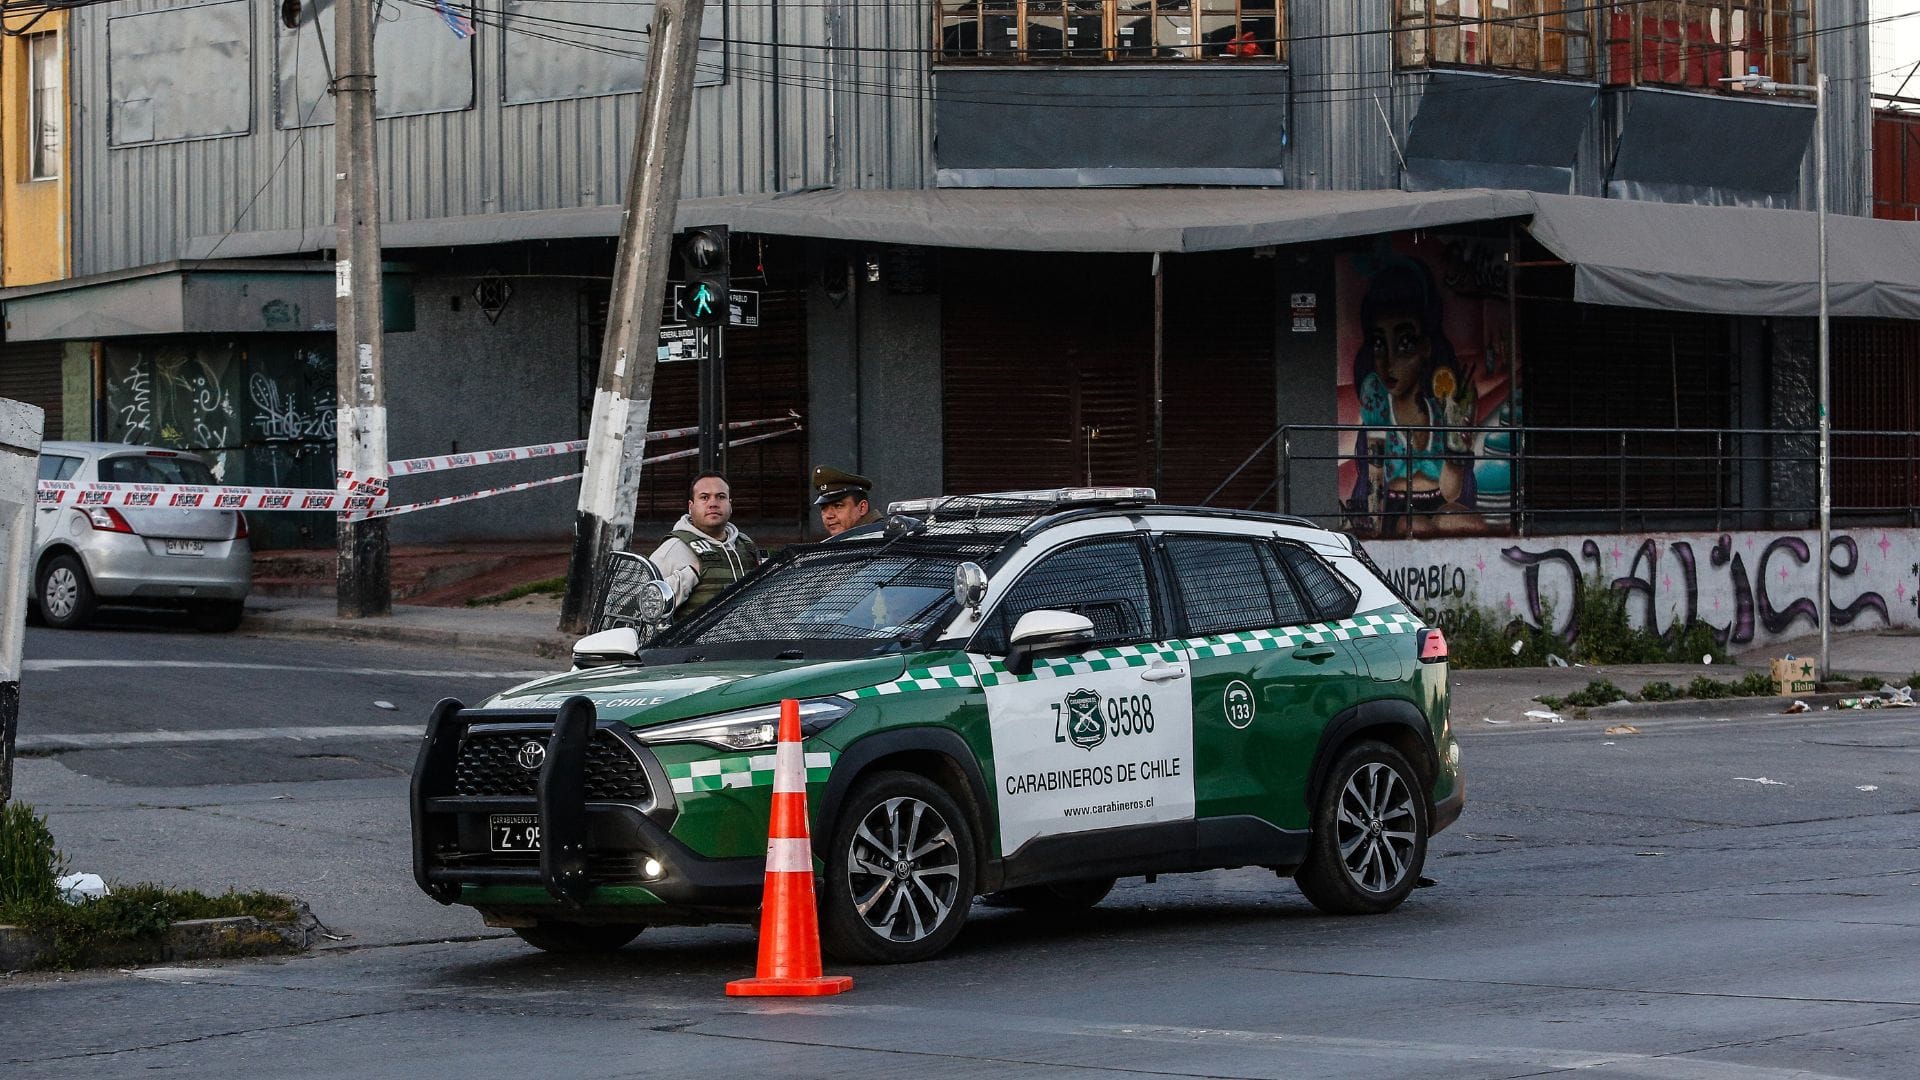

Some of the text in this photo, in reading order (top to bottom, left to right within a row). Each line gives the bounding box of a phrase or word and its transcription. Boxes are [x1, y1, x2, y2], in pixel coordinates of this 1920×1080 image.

[606, 696, 665, 708] CHILE
[1231, 702, 1250, 721] 133
[1051, 694, 1155, 743] Z 9588
[1006, 757, 1181, 796] CARABINEROS DE CHILE
[1063, 797, 1154, 817] www.carabineros.cl
[493, 816, 532, 824] CARABINEROS
[501, 826, 541, 848] Z 95
